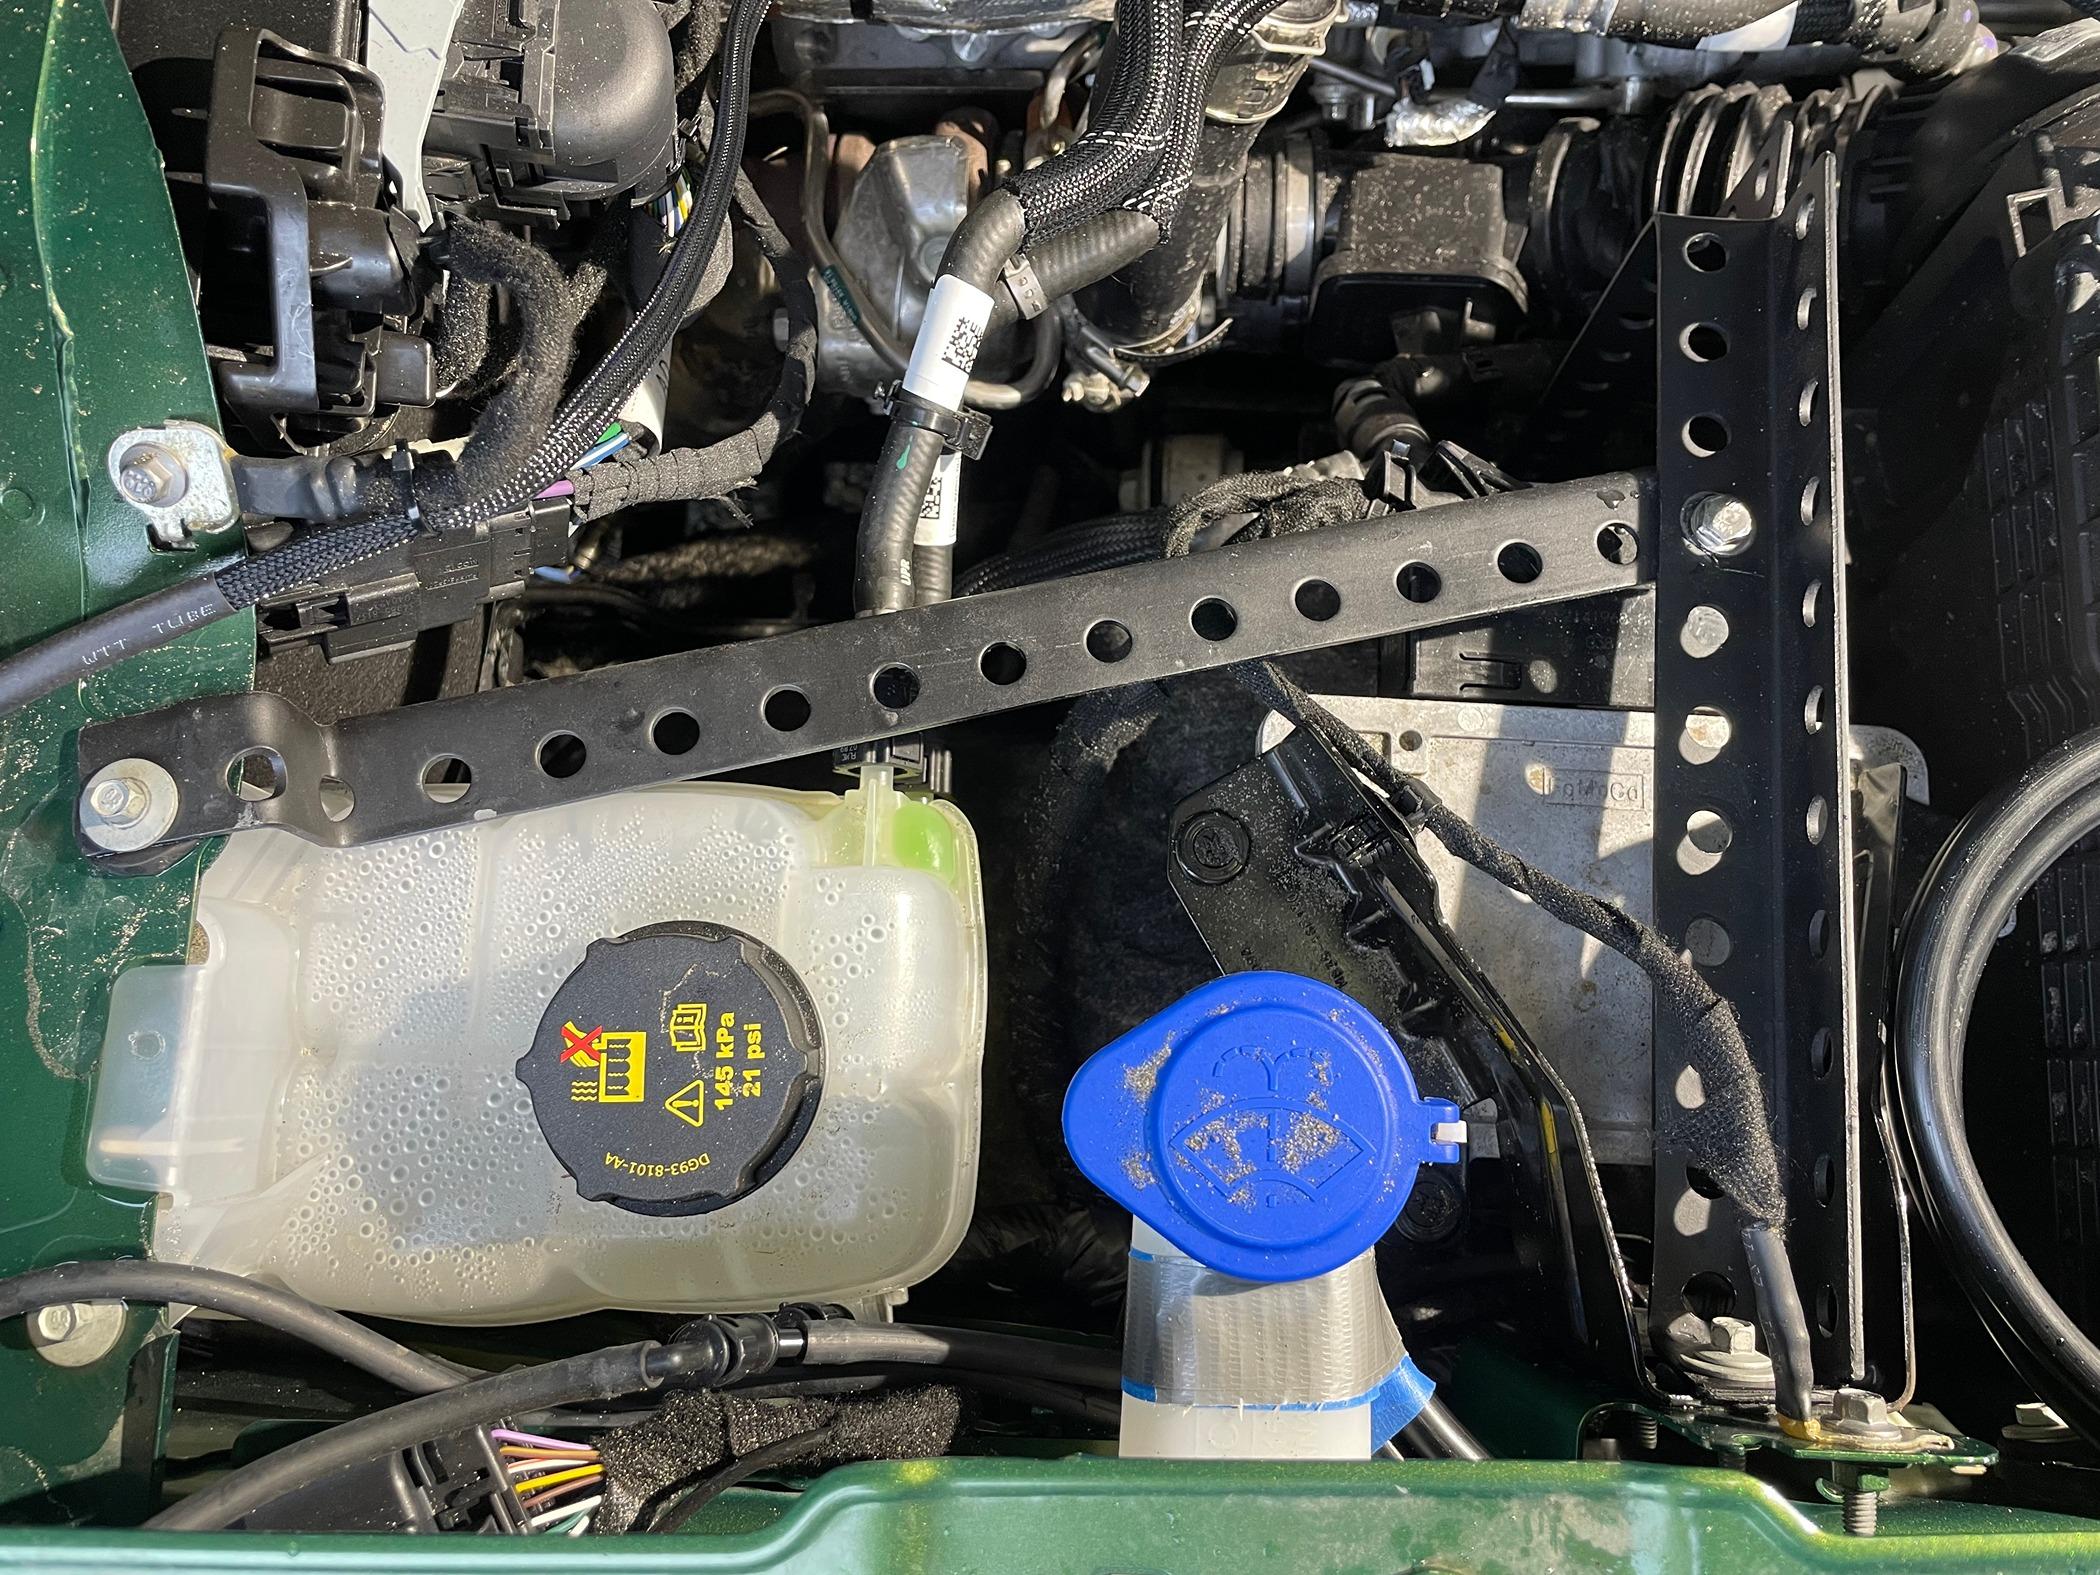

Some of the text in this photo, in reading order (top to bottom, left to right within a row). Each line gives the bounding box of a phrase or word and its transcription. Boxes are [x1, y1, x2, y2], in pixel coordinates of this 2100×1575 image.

[900, 558, 911, 586] UPR
[152, 604, 216, 634] TUBE
[714, 1012, 735, 1111] 145 kPa
[742, 1023, 766, 1098] 21 psi
[605, 1151, 712, 1178] DG93-8101-AA
